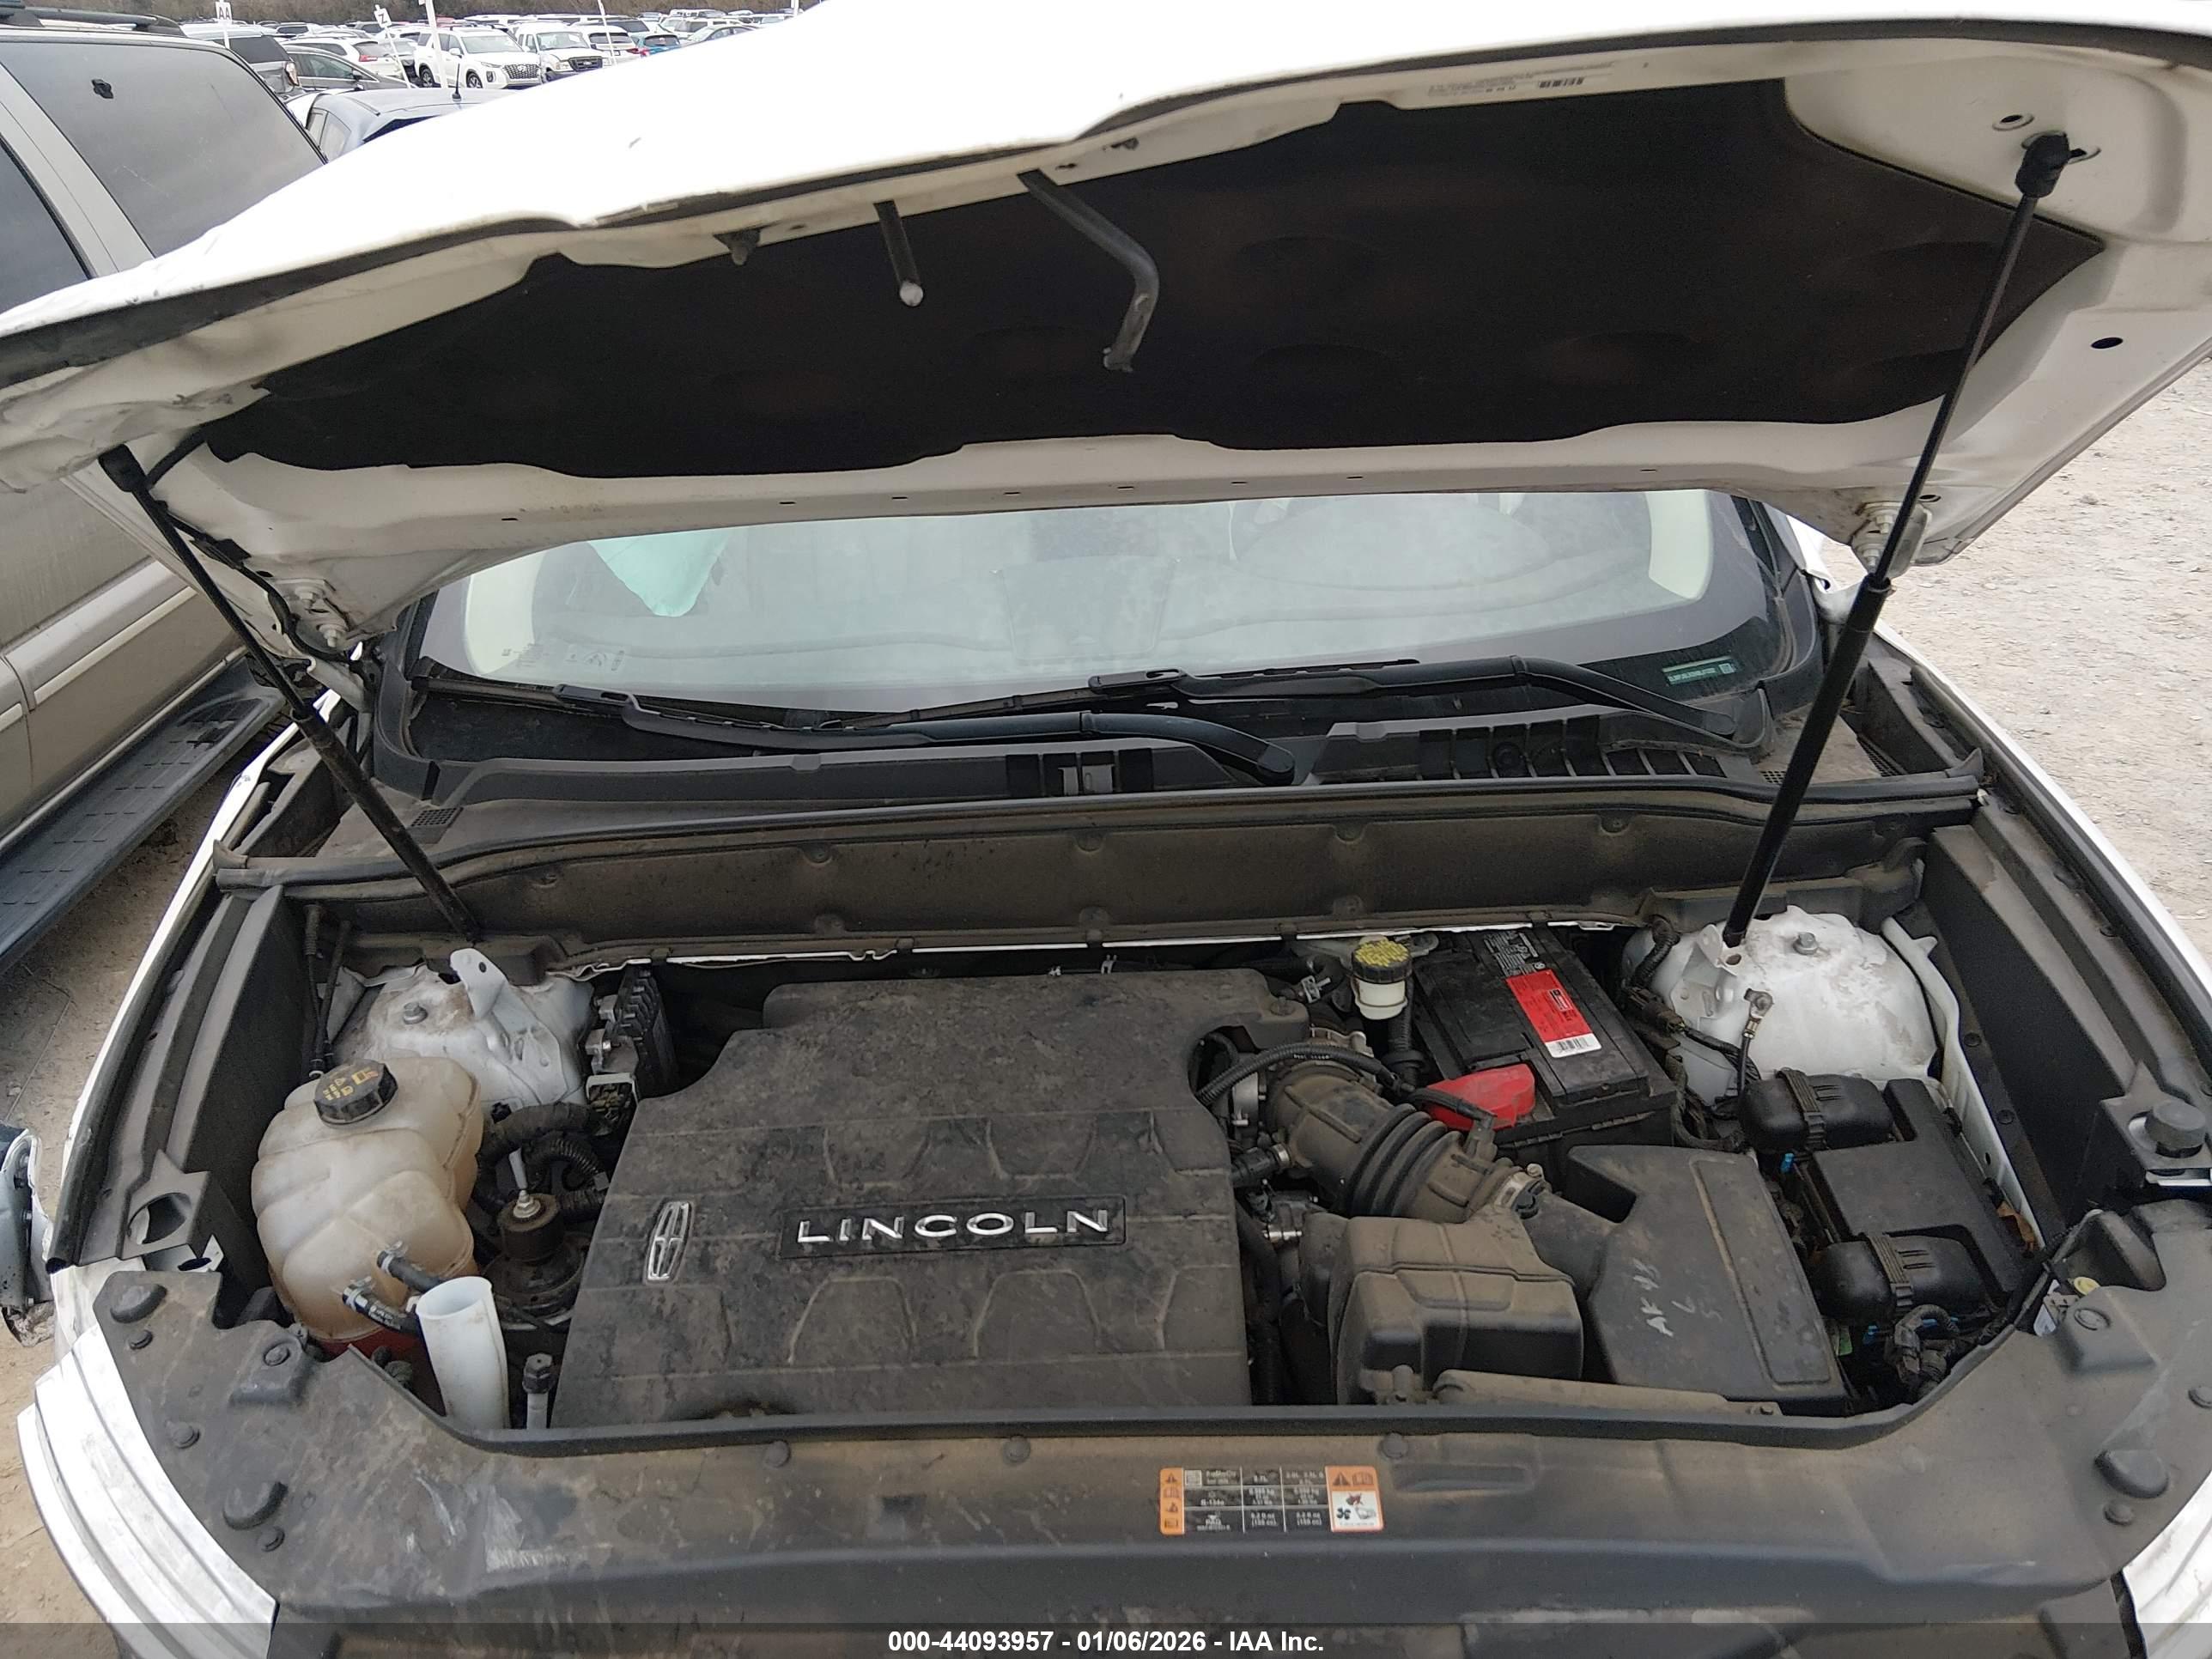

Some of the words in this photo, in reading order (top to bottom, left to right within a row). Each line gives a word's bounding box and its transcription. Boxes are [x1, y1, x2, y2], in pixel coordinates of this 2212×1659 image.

[219, 7, 231, 20] AA
[378, 13, 388, 24] Z
[797, 1209, 1109, 1243] LINCOLN
